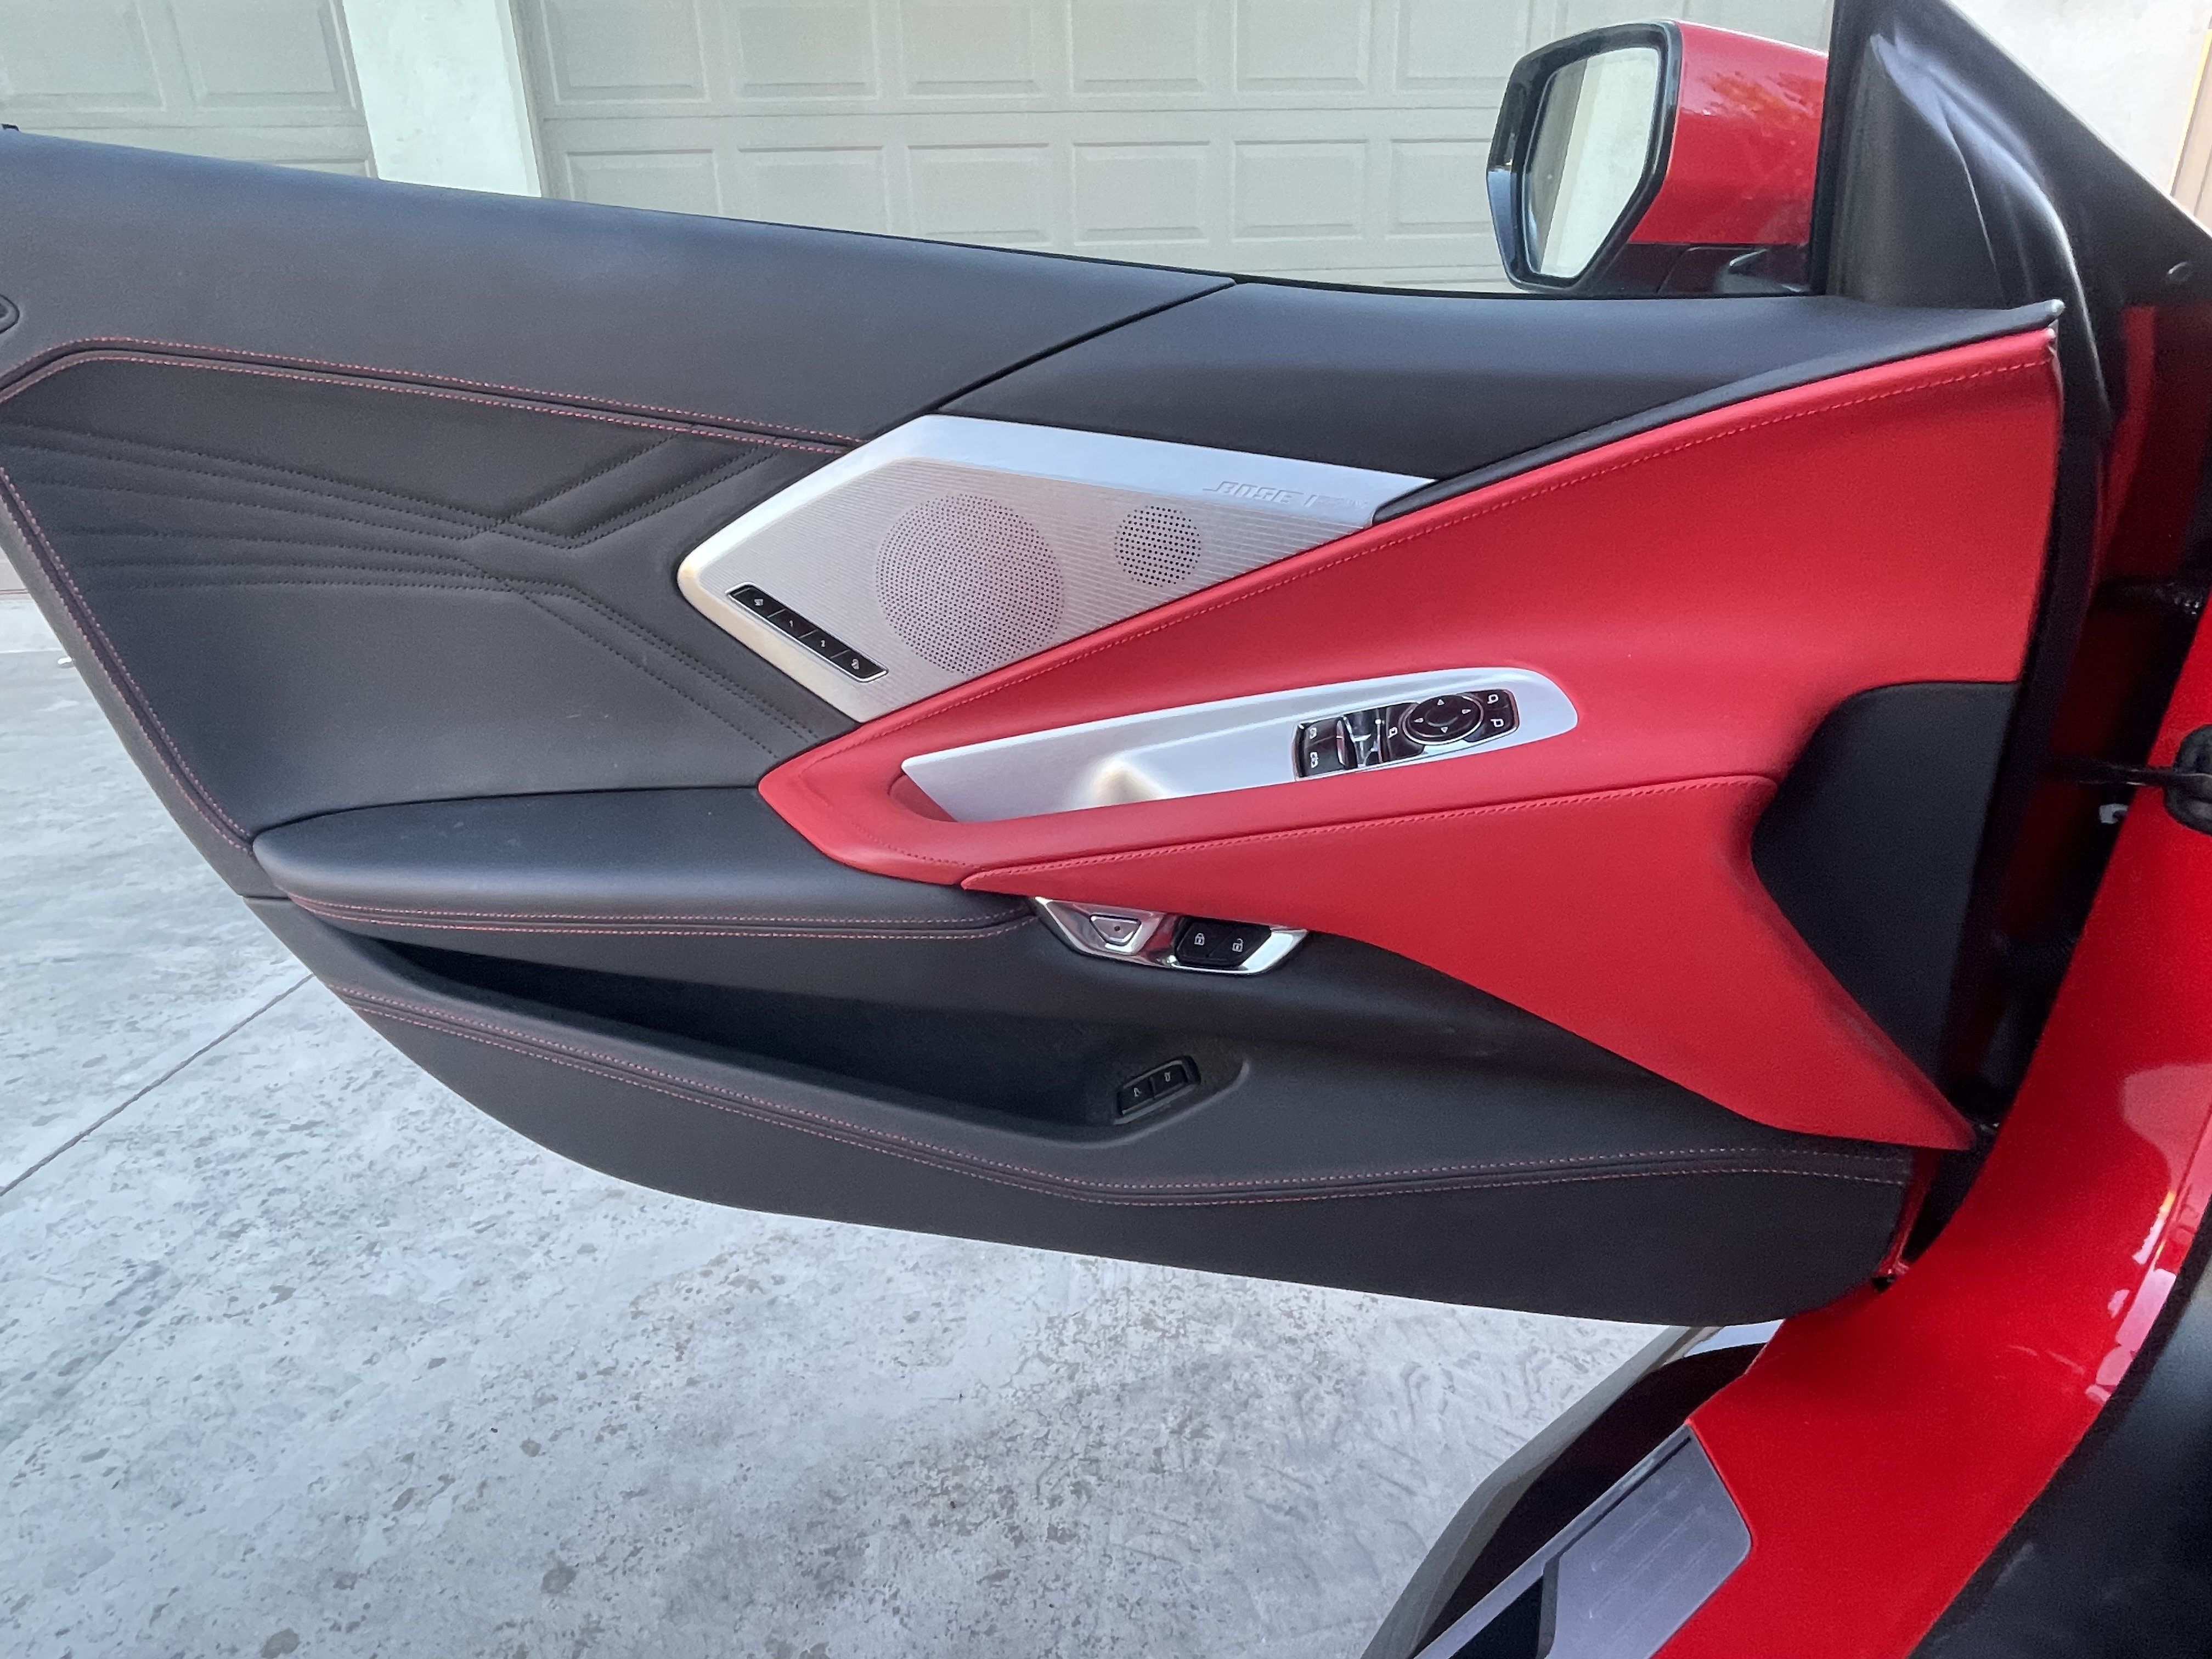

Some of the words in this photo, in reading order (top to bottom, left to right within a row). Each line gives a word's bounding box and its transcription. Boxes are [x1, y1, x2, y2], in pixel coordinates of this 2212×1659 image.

[1202, 481, 1304, 504] BOSE
[789, 620, 793, 628] 1
[820, 640, 826, 648] 2
